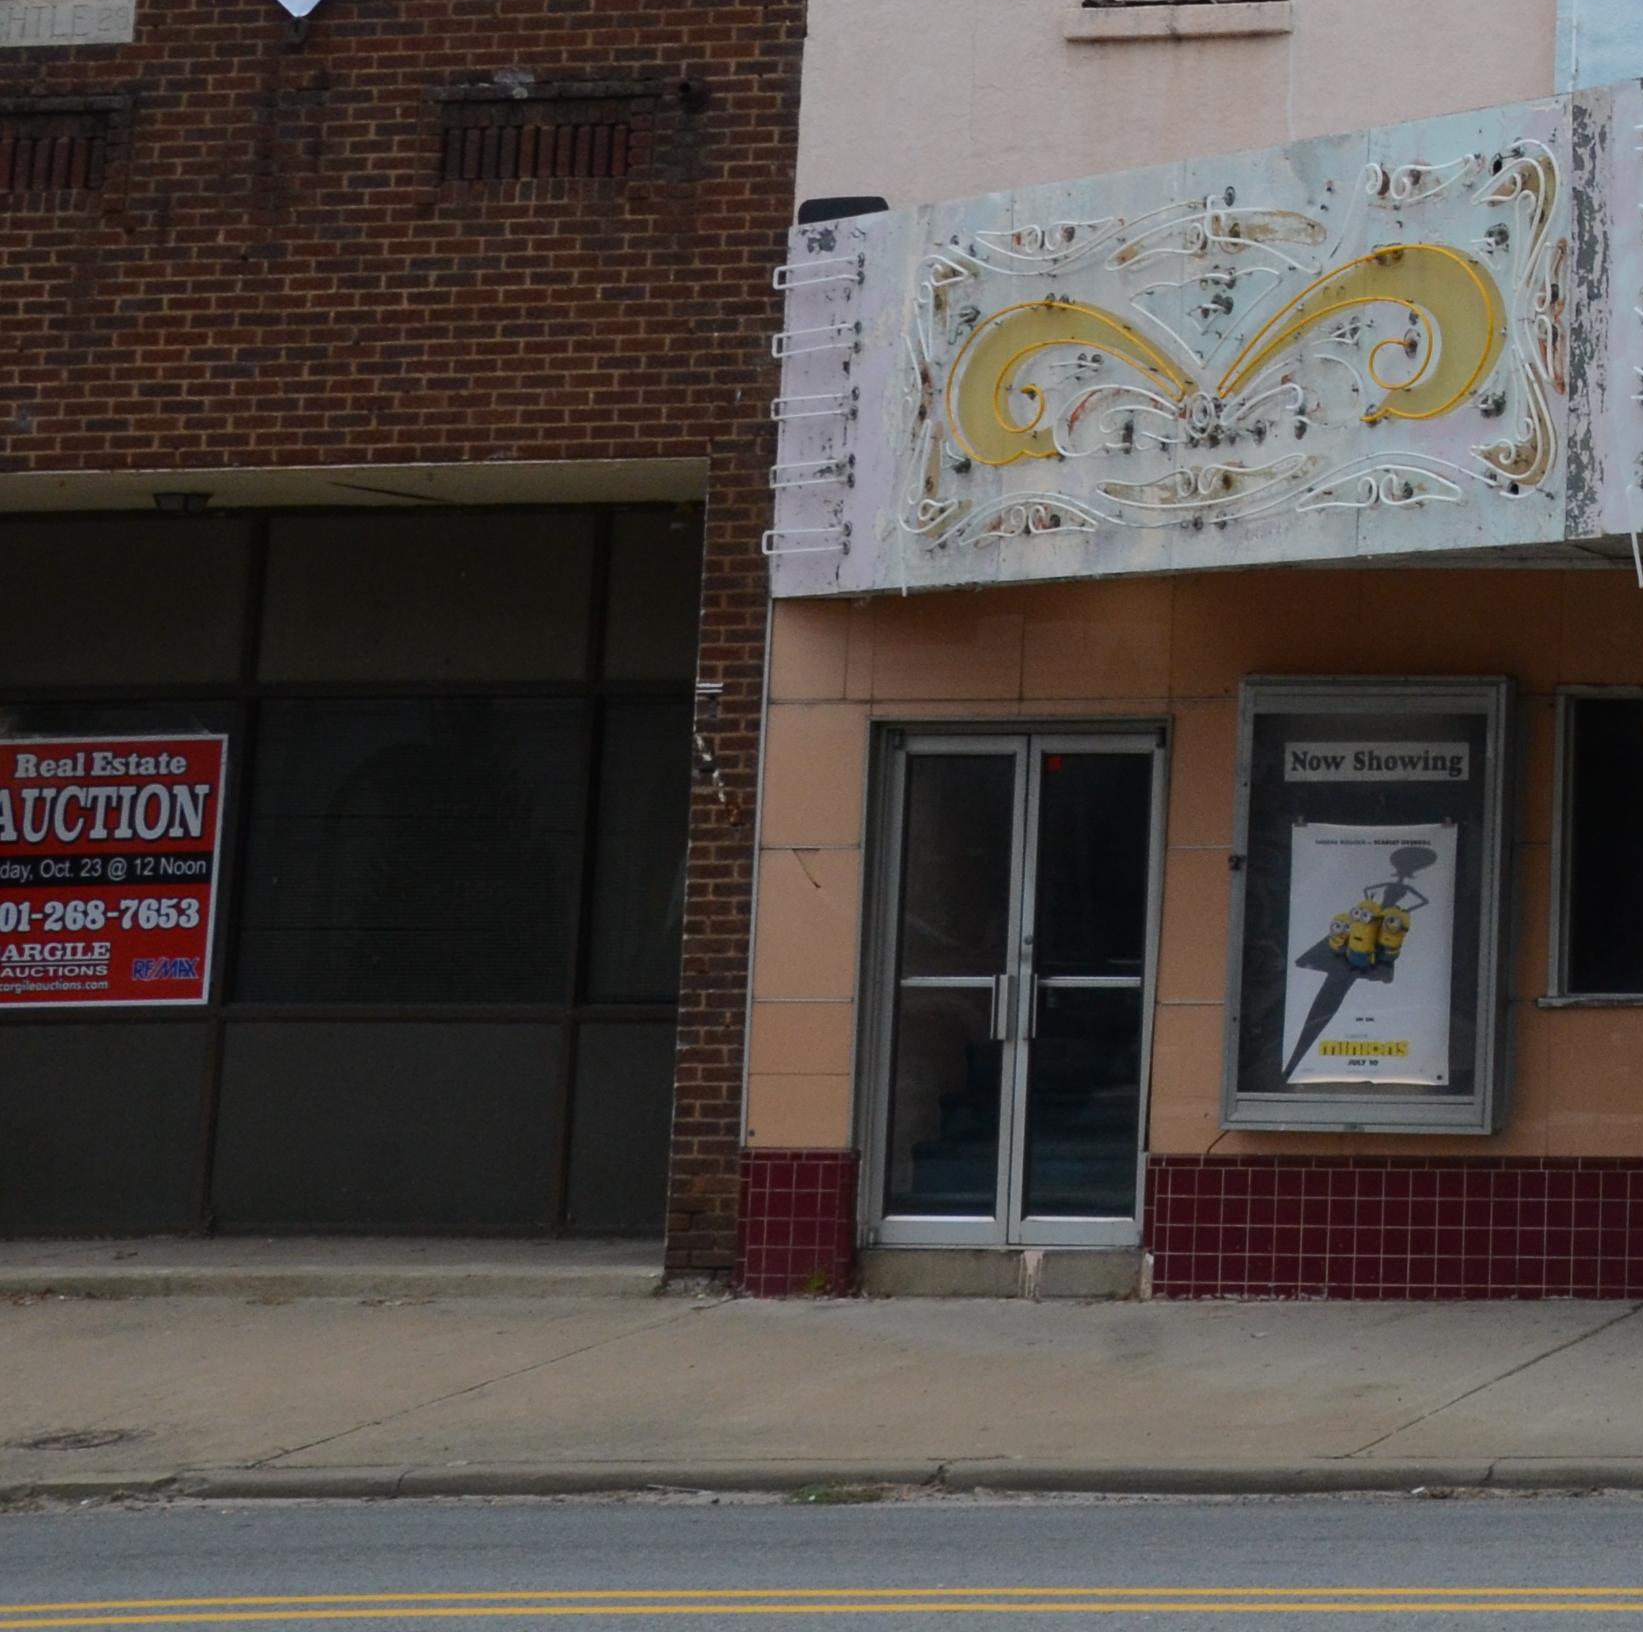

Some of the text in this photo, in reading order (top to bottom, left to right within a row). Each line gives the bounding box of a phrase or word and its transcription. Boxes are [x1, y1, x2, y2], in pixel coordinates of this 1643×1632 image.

[14, 752, 187, 778] Real Estate
[1291, 749, 1464, 778] Now Showing
[40, 859, 75, 878] Oct.
[80, 858, 102, 877] 23
[107, 857, 128, 880] @
[135, 857, 155, 876] 12
[160, 856, 206, 875] Noon
[0, 965, 108, 977] AUCTIONS
[131, 956, 200, 981] RE/MAX
[1347, 1059, 1366, 1067] JULY
